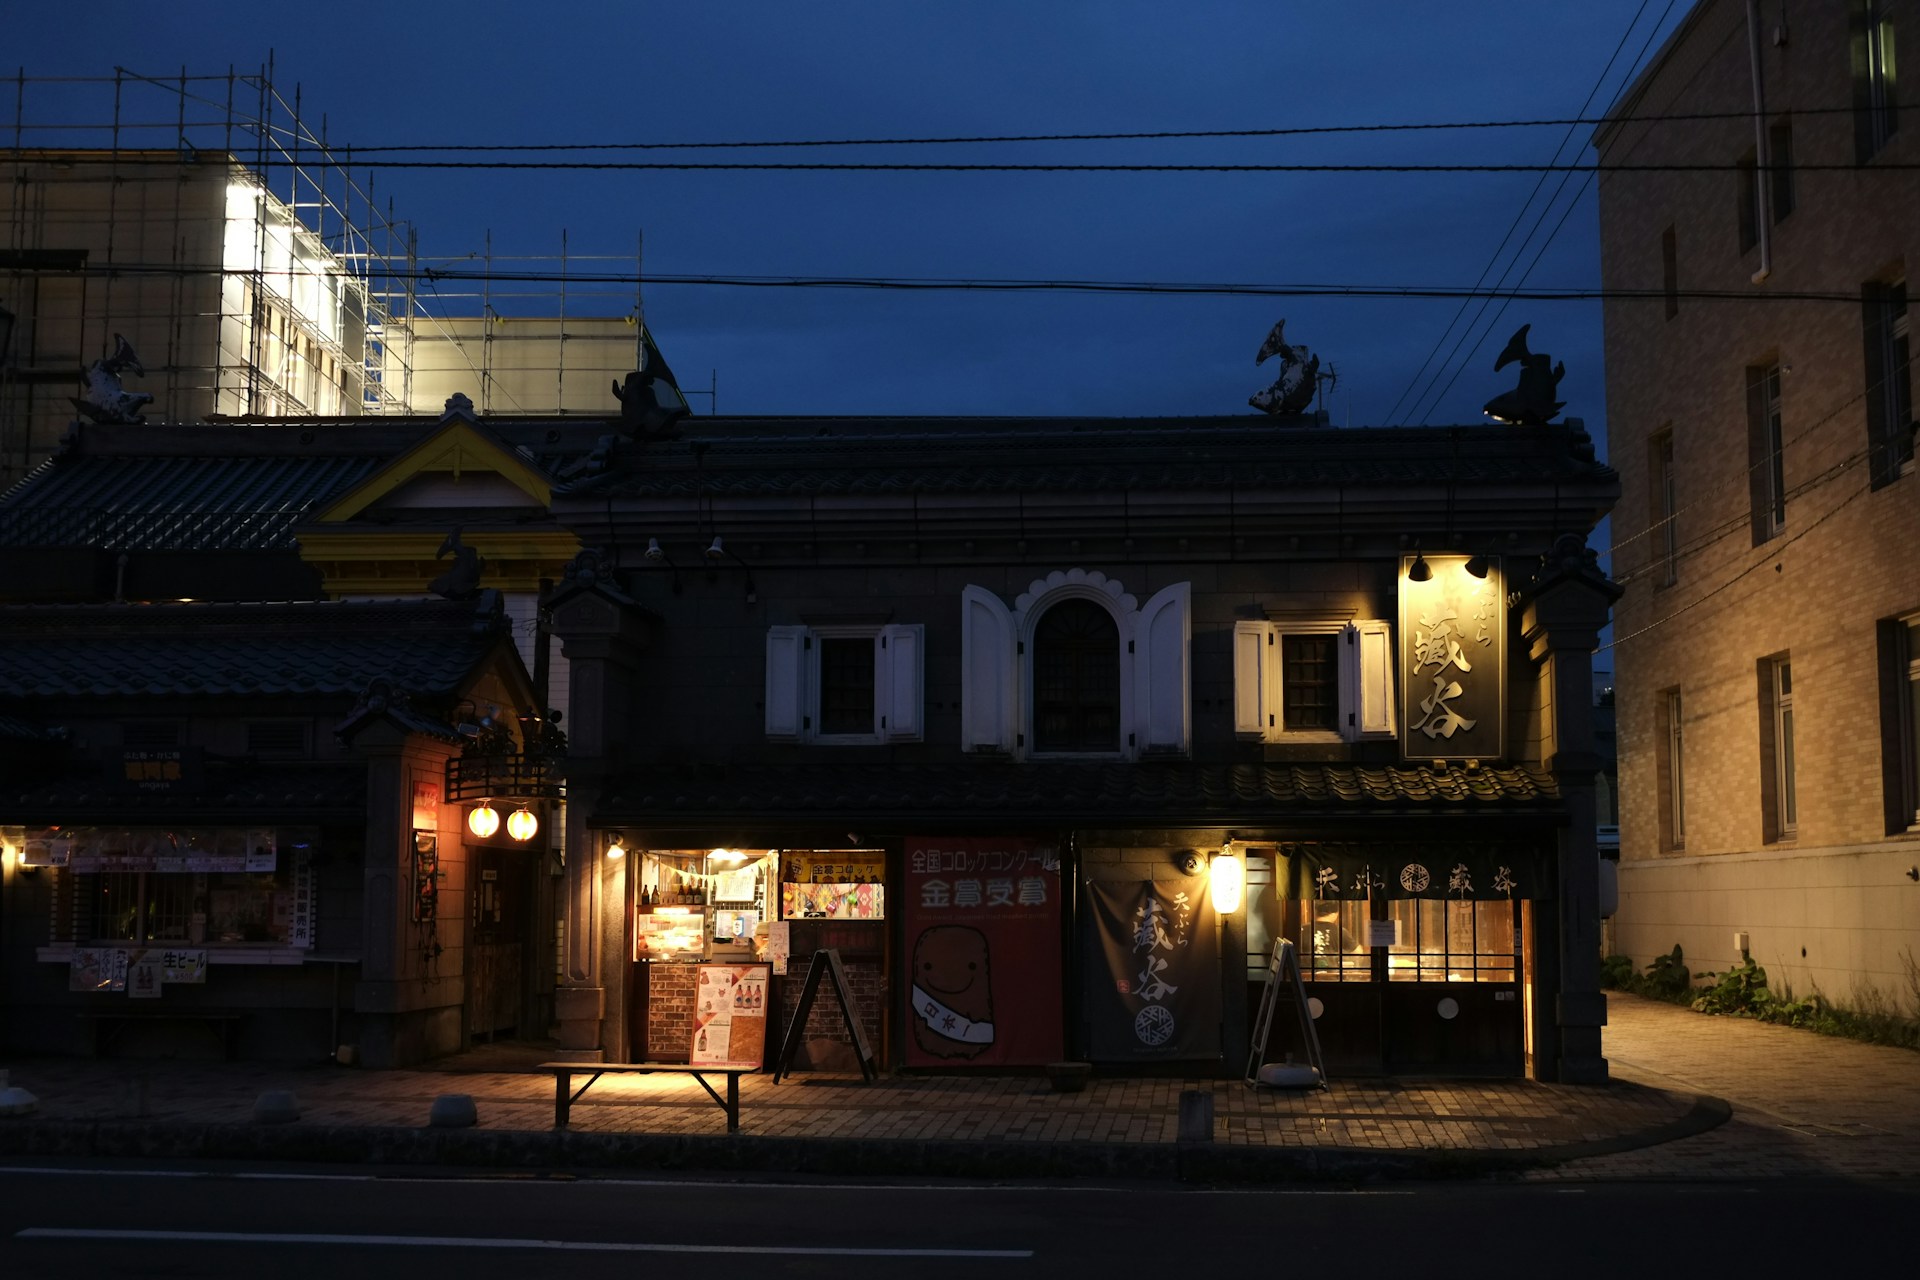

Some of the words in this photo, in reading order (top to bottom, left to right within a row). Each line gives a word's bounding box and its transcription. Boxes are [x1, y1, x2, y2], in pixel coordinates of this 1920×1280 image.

[813, 864, 875, 875] 金賞コロッケ
[911, 849, 1060, 874] 全国コロッケコンクール
[920, 876, 1047, 908] 金賞受賞
[164, 951, 206, 969] 生ビール
[924, 1001, 971, 1037] 日本一
